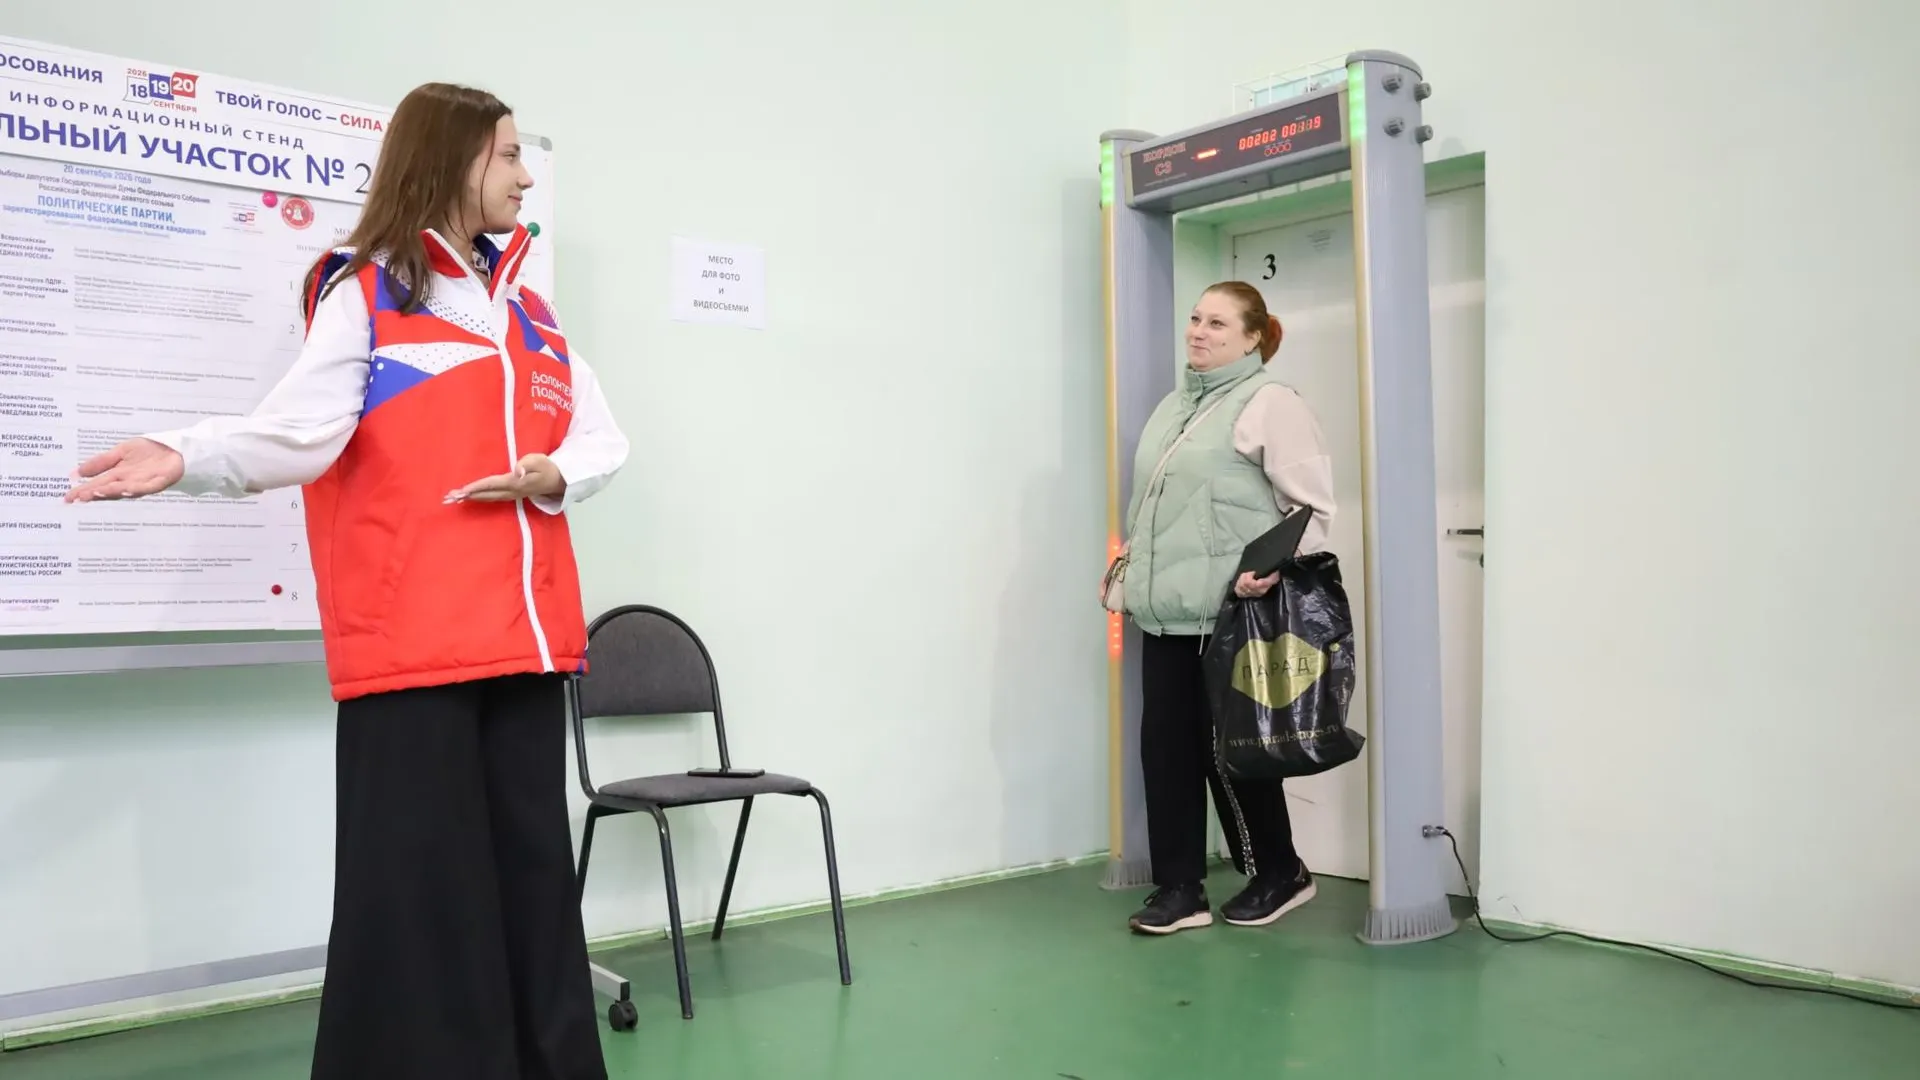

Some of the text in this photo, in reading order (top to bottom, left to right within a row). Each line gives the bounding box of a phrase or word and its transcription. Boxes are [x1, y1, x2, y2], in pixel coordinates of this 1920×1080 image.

[127, 68, 147, 77] 2026
[130, 77, 194, 98] 18 19 20
[153, 100, 197, 113] СЕНТЯБРЯ
[215, 90, 262, 111] ТВОЙ
[267, 100, 322, 121] ГОЛОС
[340, 113, 383, 132] СИЛА
[10, 90, 304, 150] ИНФОРМАЦИОННЫЙ СТЕНД
[1238, 128, 1278, 151] 00202
[138, 134, 292, 180] УЧАСТОК
[306, 154, 345, 187] №
[63, 164, 73, 174] 20
[75, 167, 112, 180] сентября
[134, 174, 152, 185] года
[37, 195, 175, 224] ПОЛИТИЧЕСКИЕ ПАРТИИ,
[708, 255, 734, 265] МЕСТО
[1262, 253, 1276, 280] 3
[701, 269, 741, 282] ДЛЯ ФОТО
[718, 287, 724, 295] И
[291, 500, 298, 510] 6
[291, 543, 298, 553] 7
[291, 591, 298, 601] 8
[1242, 656, 1311, 680] ПАРАД
